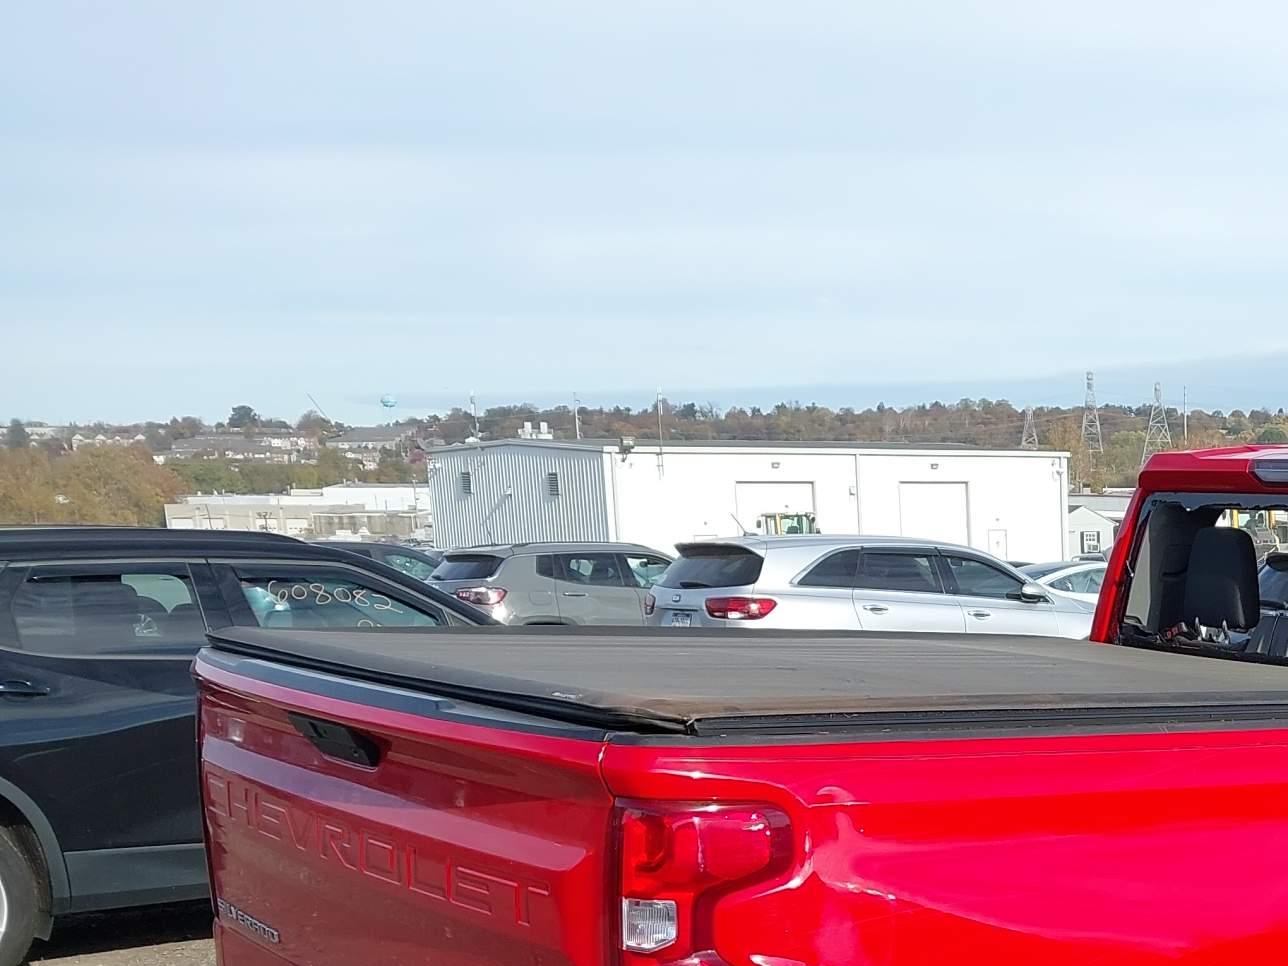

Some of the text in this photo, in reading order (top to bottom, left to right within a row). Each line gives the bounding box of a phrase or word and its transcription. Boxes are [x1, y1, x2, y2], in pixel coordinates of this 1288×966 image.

[267, 580, 403, 614] 608082
[205, 770, 551, 928] CHEVROLET
[217, 897, 279, 943] SILVERADO
